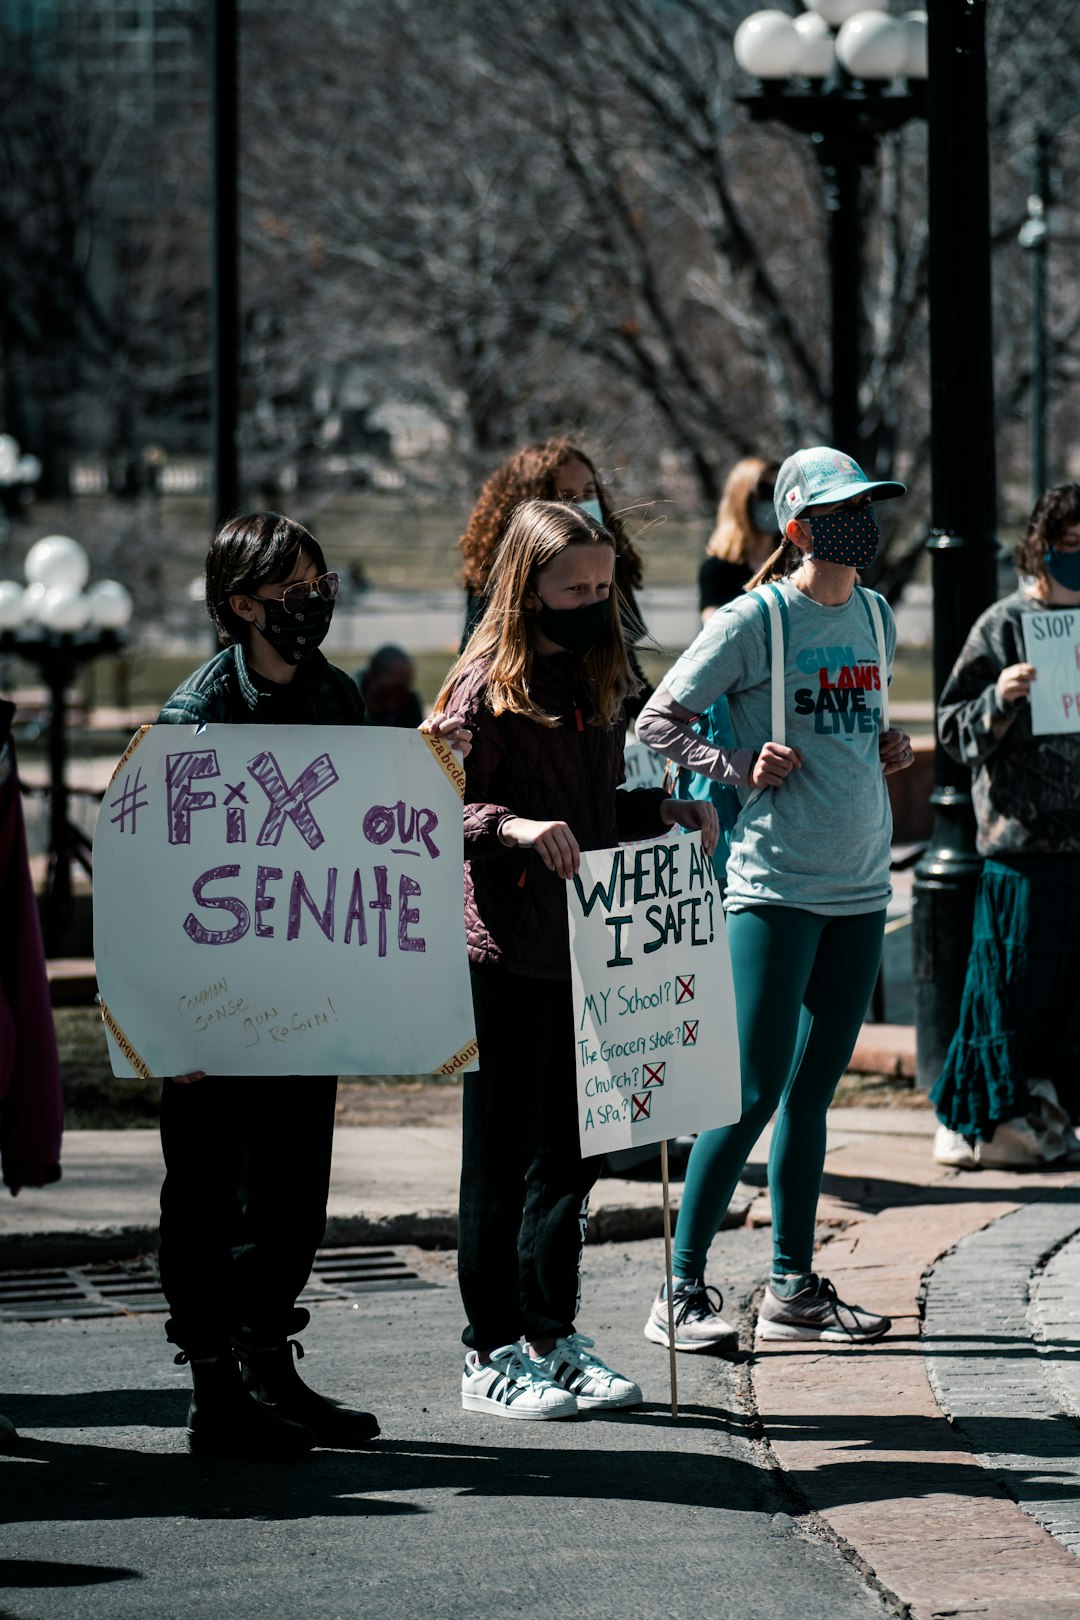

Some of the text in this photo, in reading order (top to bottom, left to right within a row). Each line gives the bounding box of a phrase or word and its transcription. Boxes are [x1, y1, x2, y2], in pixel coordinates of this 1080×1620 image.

[1031, 614, 1075, 640] STOP
[796, 646, 856, 675] GUN
[819, 665, 881, 691] LAWS
[794, 688, 866, 715] SAVE
[814, 707, 881, 734] LIVES
[573, 843, 682, 917] WHERE
[605, 890, 714, 968] I SAFE?
[580, 981, 671, 1031] MY School?
[577, 1039, 598, 1067] The
[585, 1067, 639, 1097] Church?
[584, 1108, 595, 1132] A
